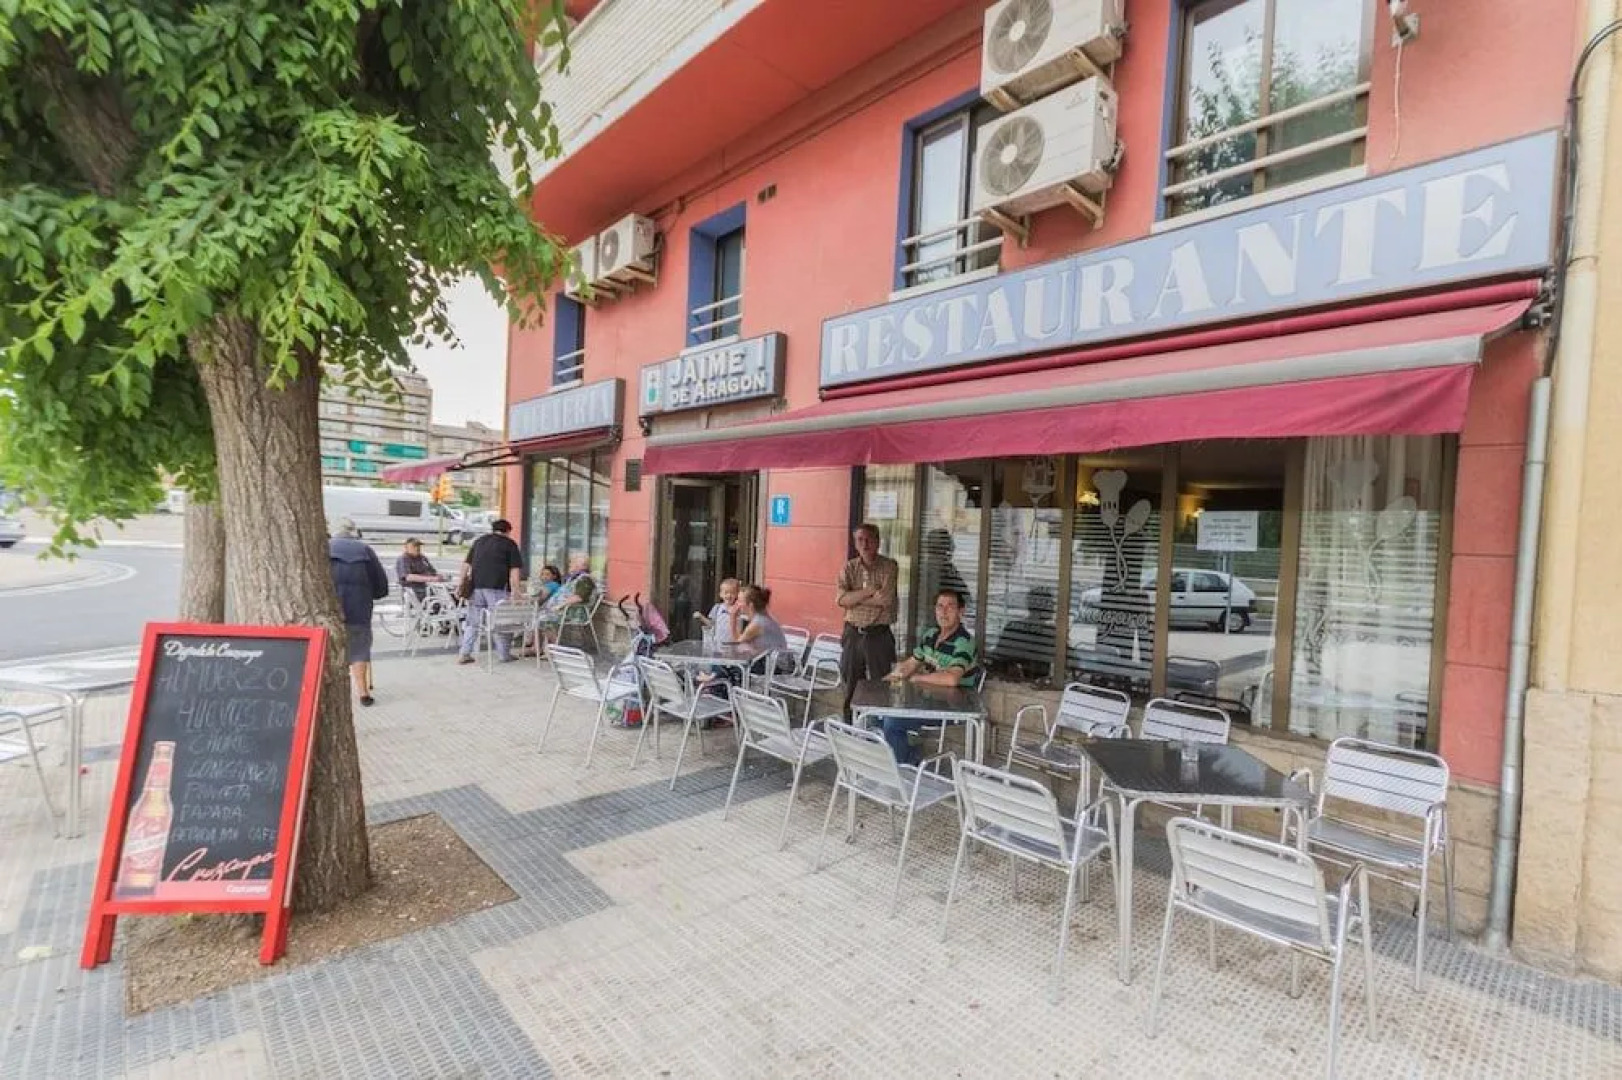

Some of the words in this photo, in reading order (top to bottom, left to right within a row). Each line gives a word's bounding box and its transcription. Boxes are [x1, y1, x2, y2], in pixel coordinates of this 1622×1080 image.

[829, 163, 1518, 377] RESTAURANTE
[668, 351, 746, 387] JAIME
[669, 388, 690, 405] DE
[694, 372, 767, 402] ARAGON
[777, 499, 785, 514] R
